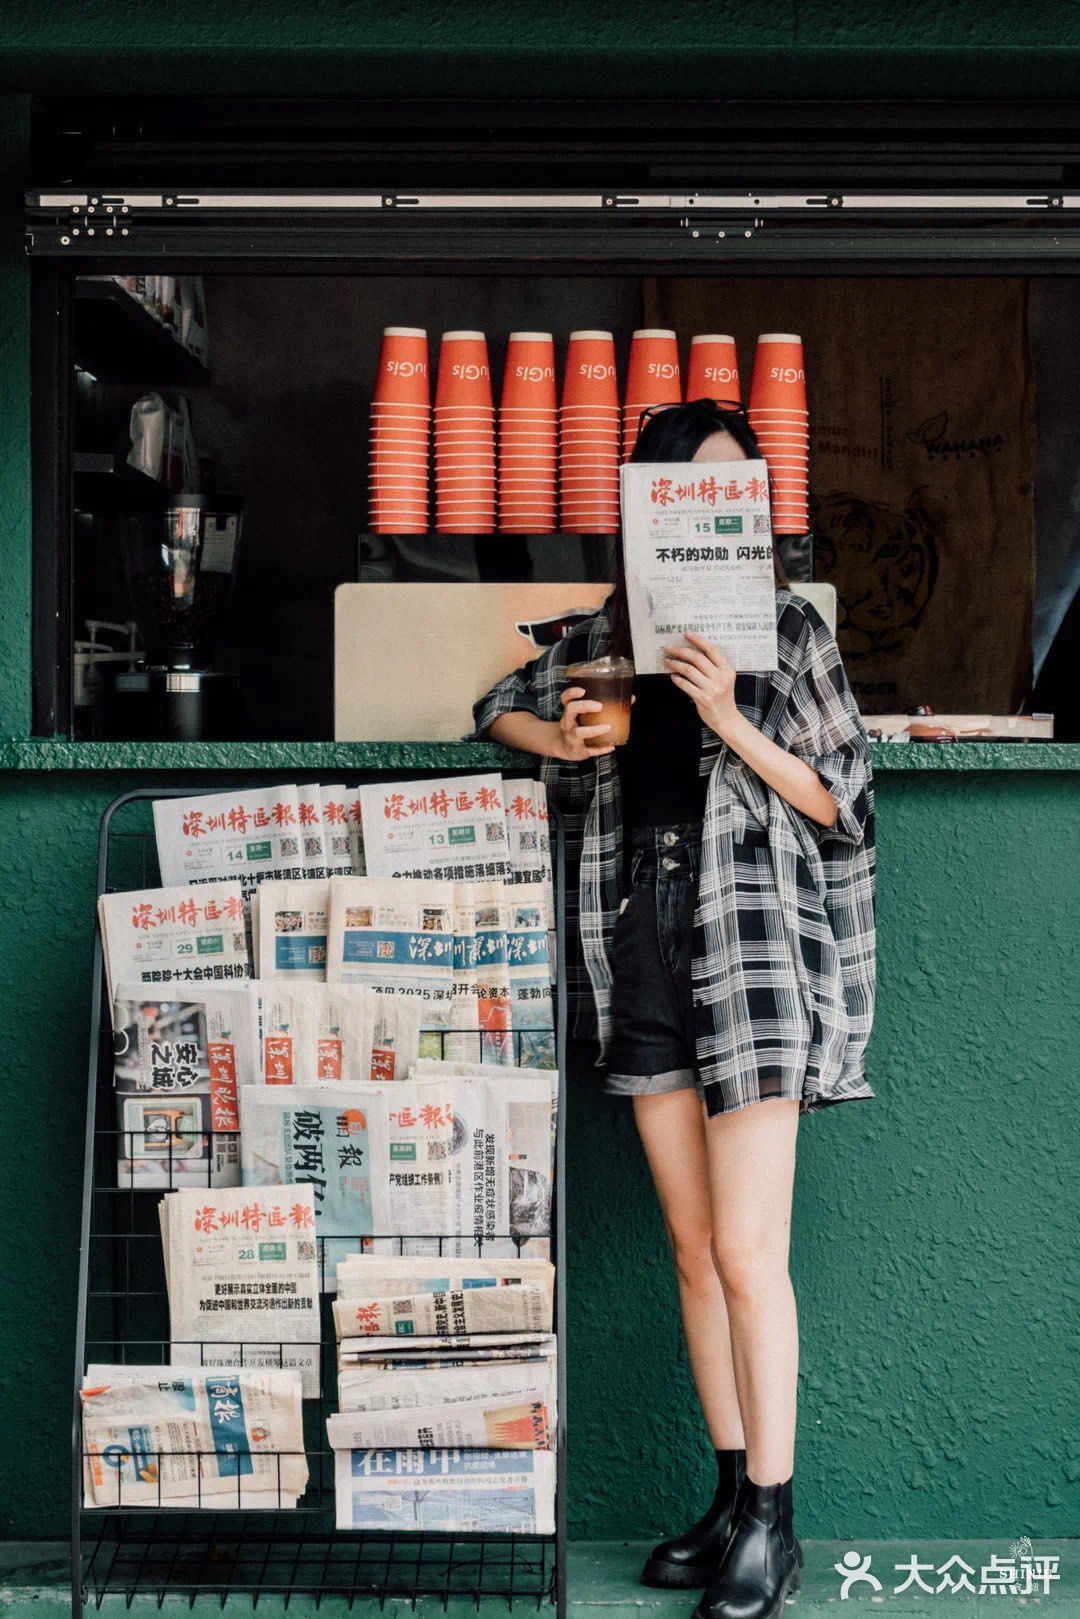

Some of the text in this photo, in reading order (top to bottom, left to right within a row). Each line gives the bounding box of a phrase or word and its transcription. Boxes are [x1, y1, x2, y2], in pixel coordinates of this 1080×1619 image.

[695, 522, 711, 533] 15
[656, 546, 729, 564] 不朽的功勋
[429, 834, 444, 845] 13
[227, 850, 243, 861] 14
[177, 944, 193, 954] 29
[485, 1133, 496, 1242] 发现新增无症状感染者
[239, 1249, 255, 1260] 28
